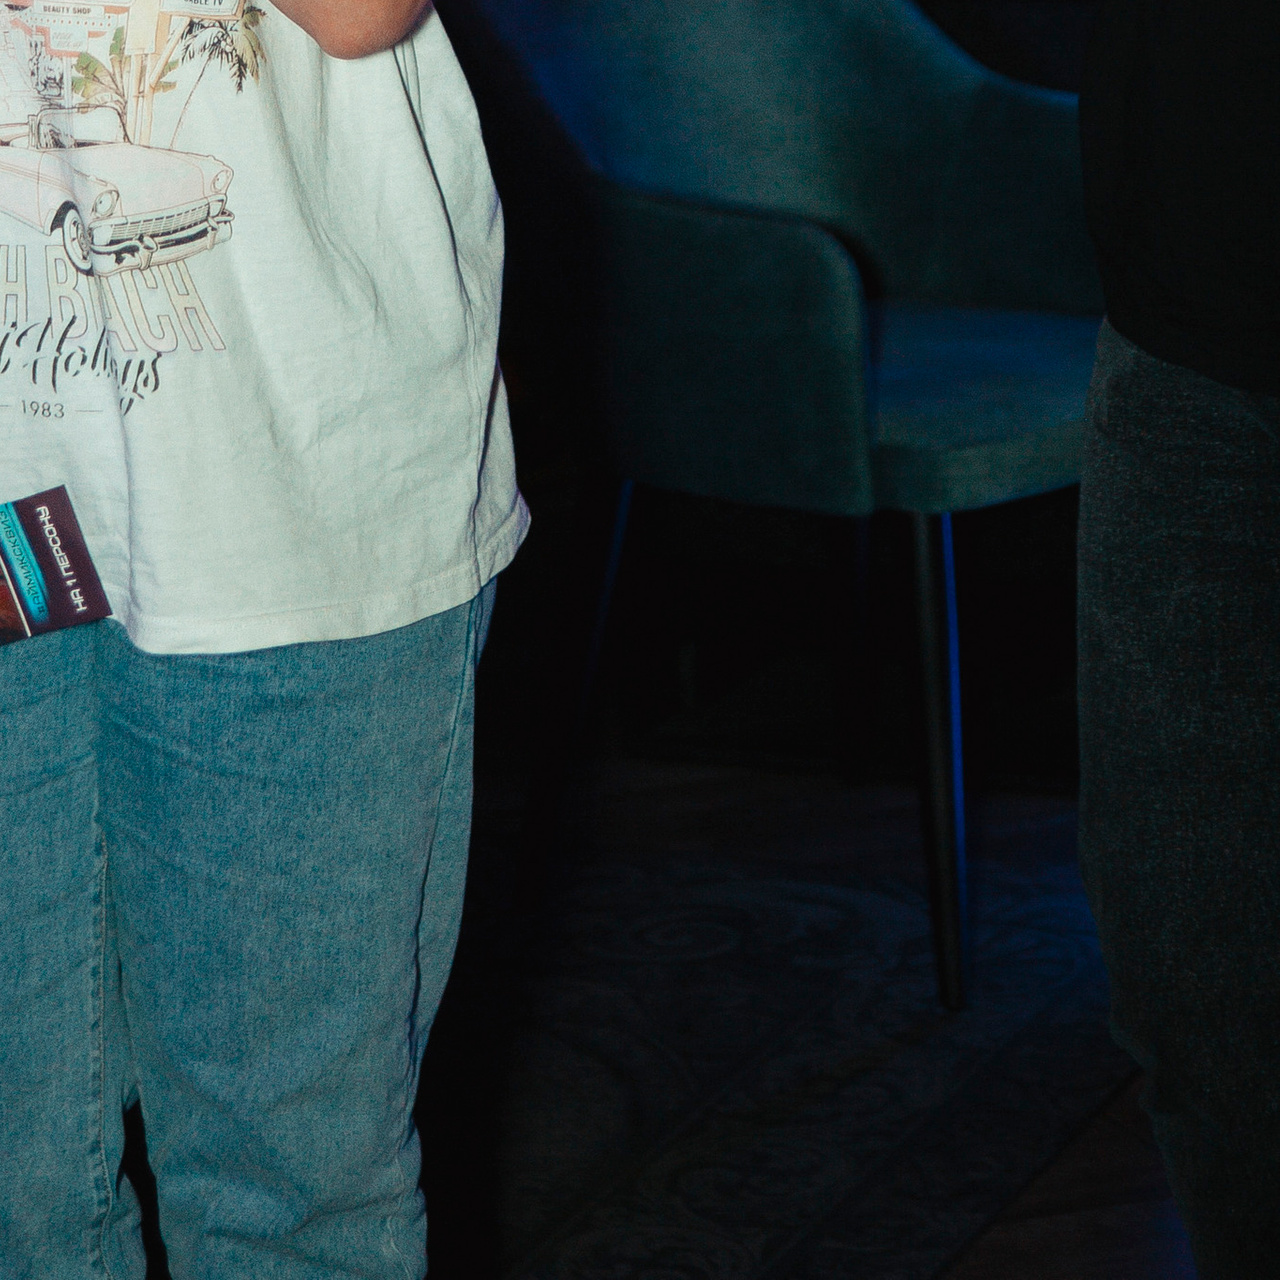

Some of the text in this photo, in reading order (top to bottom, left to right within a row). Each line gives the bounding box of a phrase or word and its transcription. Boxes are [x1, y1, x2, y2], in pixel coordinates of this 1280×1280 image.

[42, 4, 92, 16] BEAUTY SHOP
[21, 399, 65, 419] 1983
[36, 505, 74, 578] ПЕРСОНУ
[70, 588, 88, 613] НА
